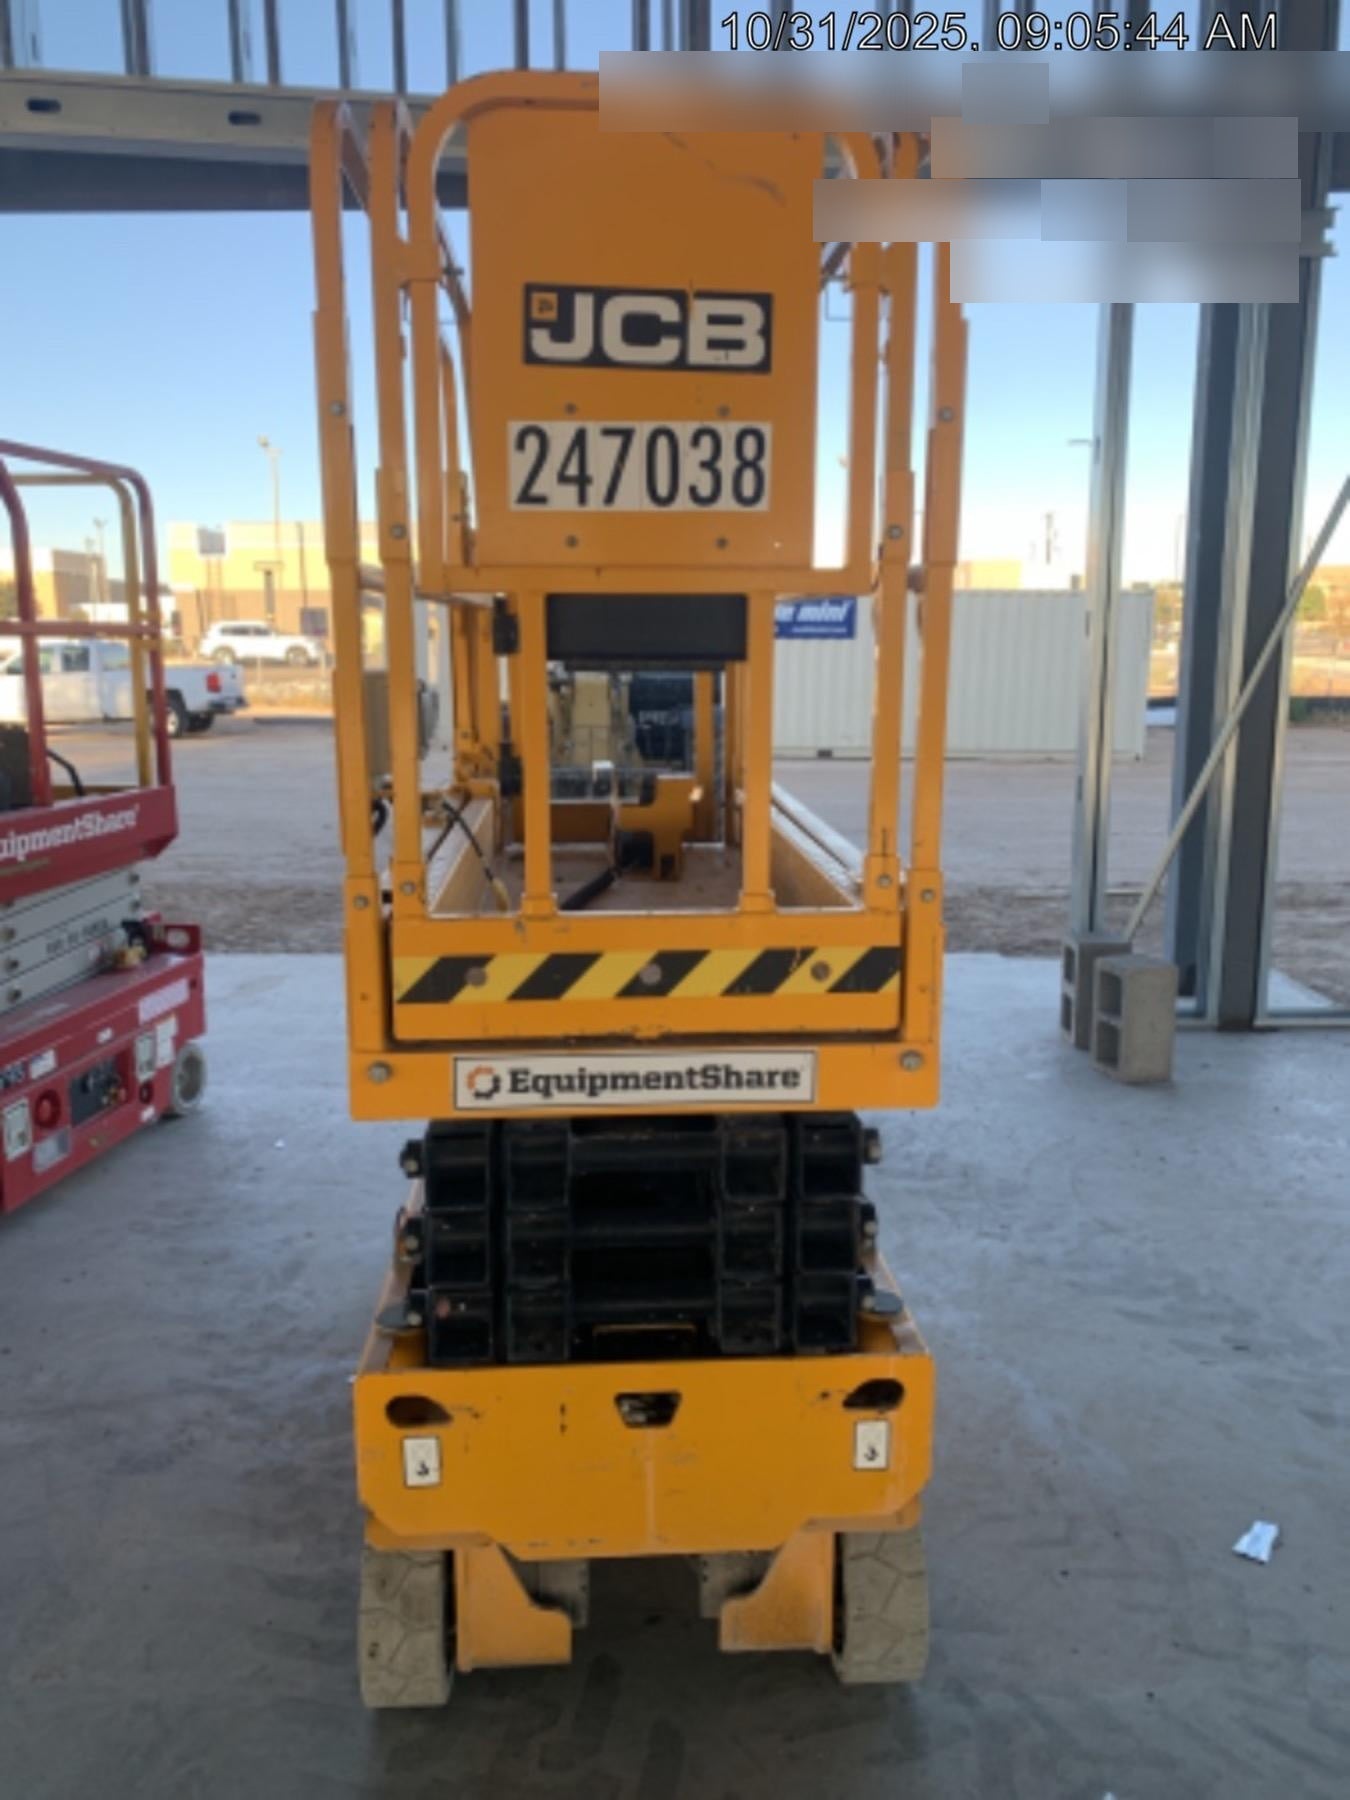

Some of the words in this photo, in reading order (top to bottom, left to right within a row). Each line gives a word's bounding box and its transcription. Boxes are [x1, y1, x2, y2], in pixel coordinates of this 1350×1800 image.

[530, 291, 766, 366] JCB
[515, 424, 766, 507] 247038
[508, 1063, 801, 1098] EquipmentShare
